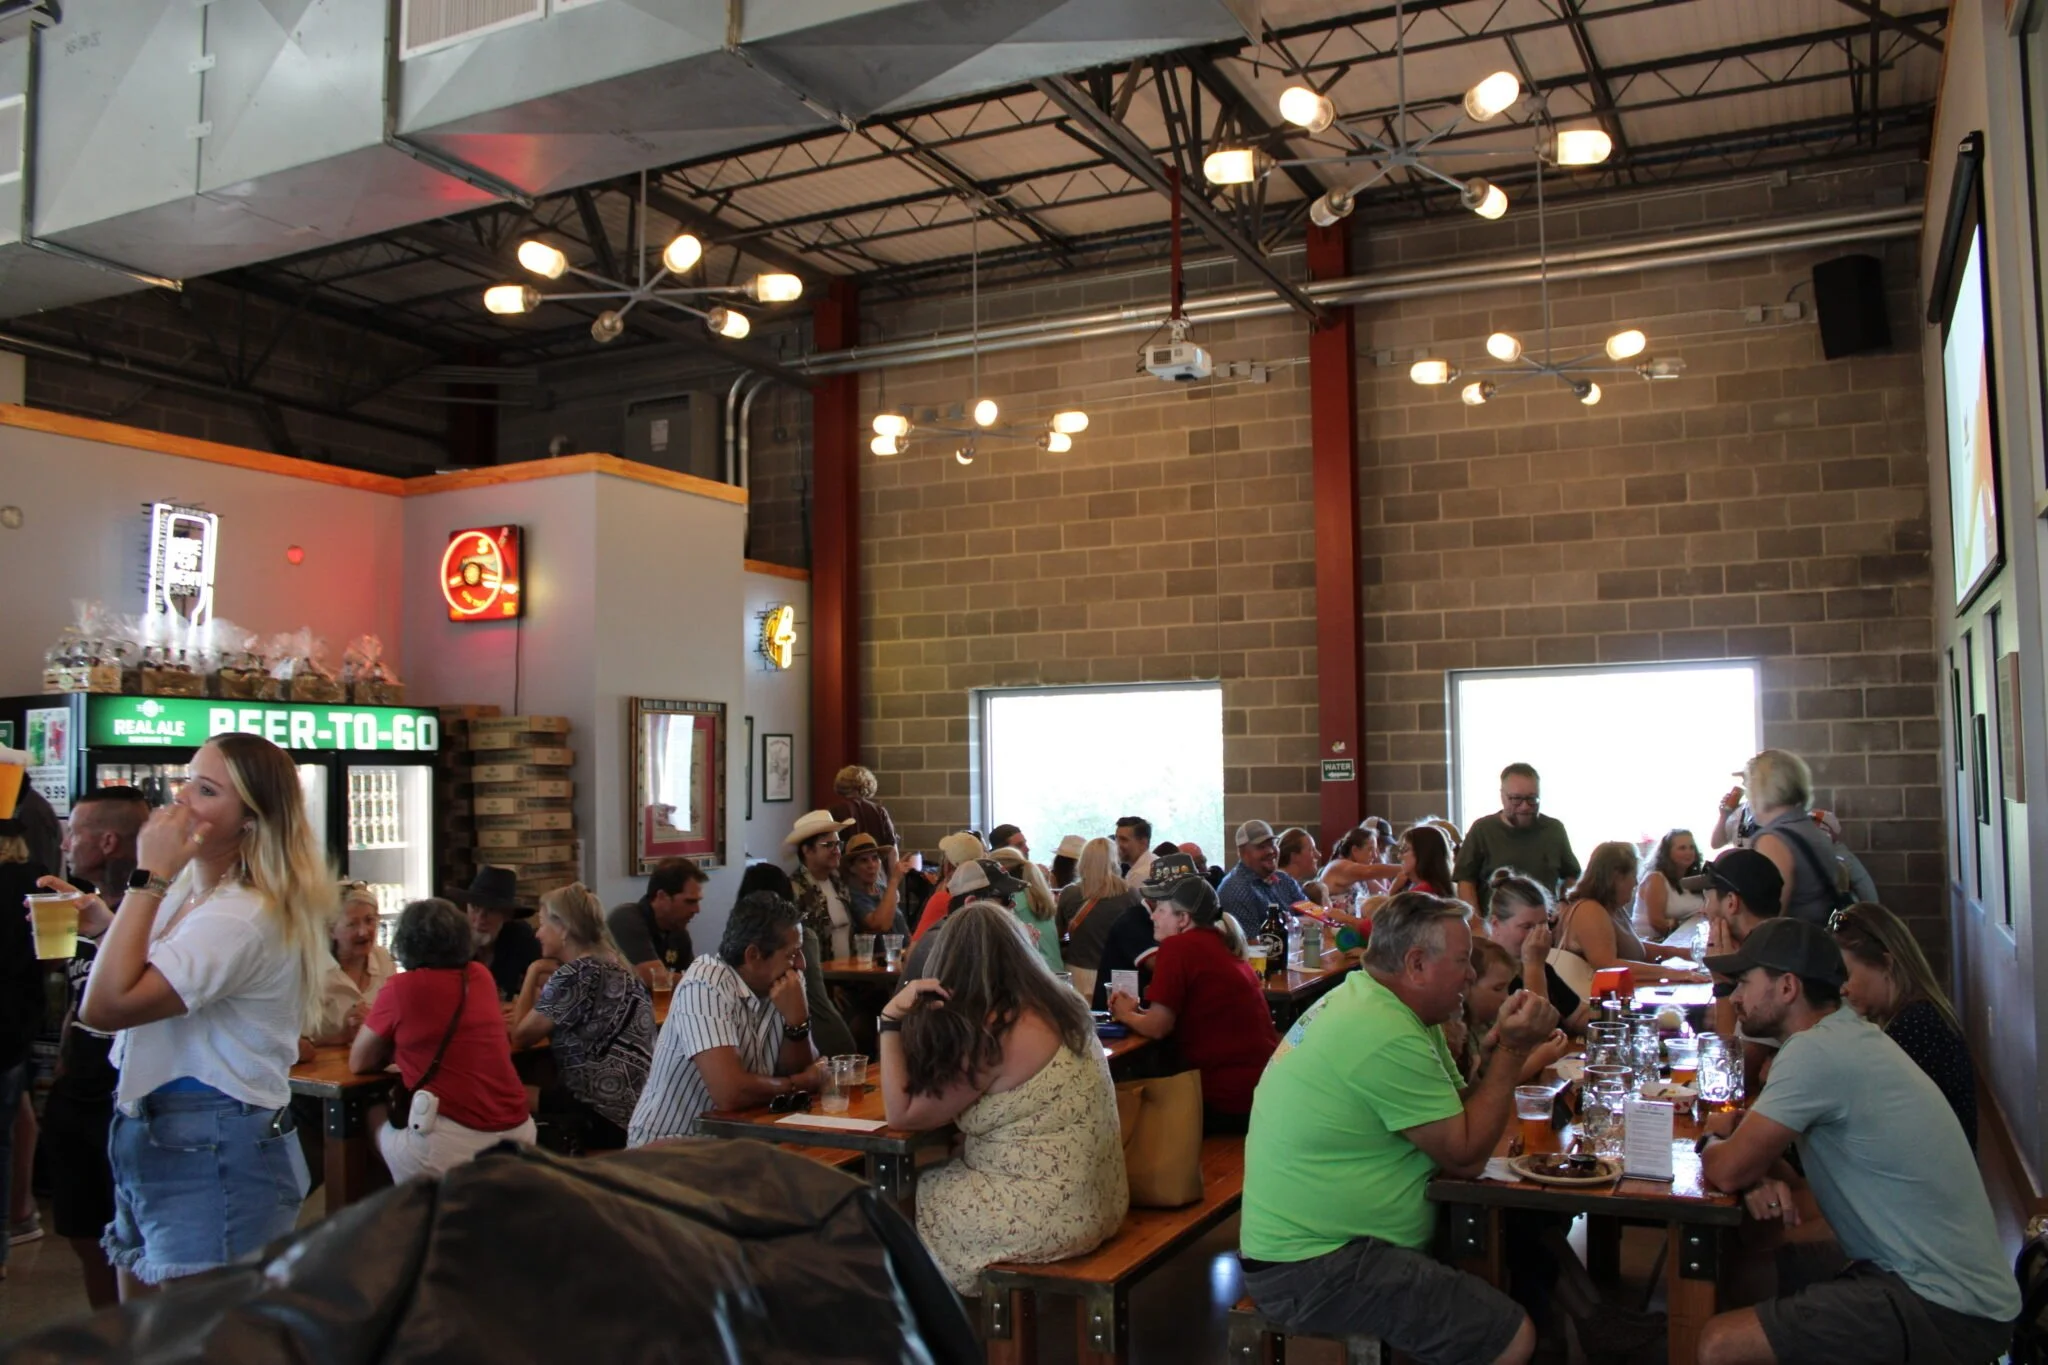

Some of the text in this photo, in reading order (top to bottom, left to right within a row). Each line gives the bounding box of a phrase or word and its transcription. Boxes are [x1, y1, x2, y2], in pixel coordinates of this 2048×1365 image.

[114, 719, 186, 737] REAL ALE
[1324, 763, 1352, 771] WATER
